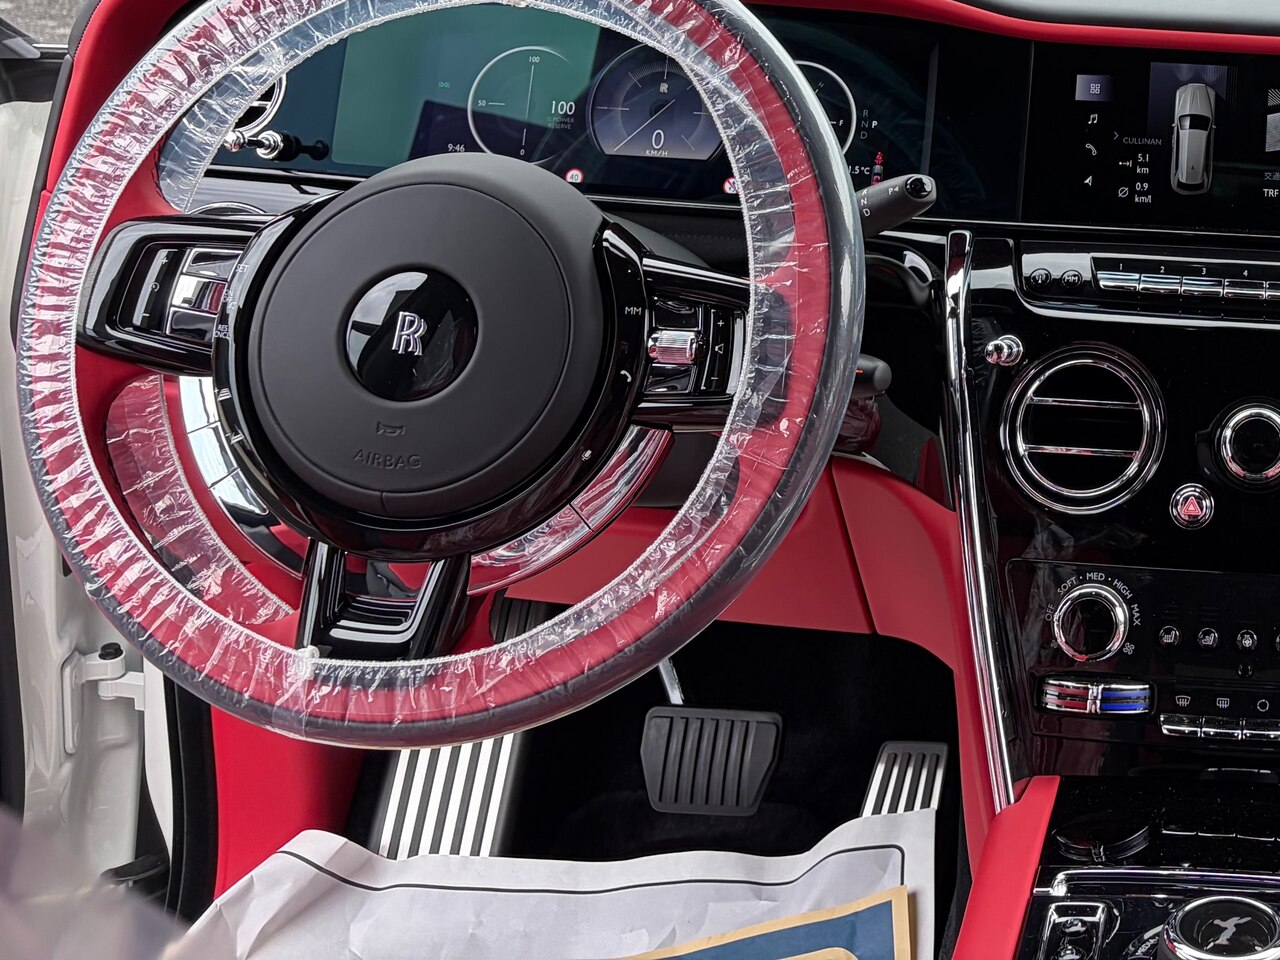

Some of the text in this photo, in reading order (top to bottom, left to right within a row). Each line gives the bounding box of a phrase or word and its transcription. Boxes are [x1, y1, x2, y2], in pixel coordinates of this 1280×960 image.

[551, 101, 576, 115] 100
[863, 109, 869, 117] R
[839, 119, 844, 127] F
[861, 120, 869, 128] N
[871, 120, 878, 129] P
[652, 129, 664, 150] 0
[860, 131, 868, 139] D
[1122, 137, 1162, 145] CULLINAN
[447, 143, 465, 152] 9:46
[645, 149, 668, 157] KM/H
[1137, 153, 1149, 162] 5.1
[1136, 165, 1149, 174] km
[569, 173, 579, 182] 40
[888, 187, 894, 195] P
[1135, 182, 1149, 191] 0.9
[1262, 188, 1279, 197] TRF
[860, 198, 867, 206] N
[863, 208, 871, 217] D
[236, 263, 250, 273] SET
[1202, 267, 1206, 275] 3
[1242, 269, 1248, 277] 4
[624, 306, 643, 315] MM
[217, 324, 229, 332] RES
[353, 448, 422, 469] AIRBAG
[1086, 572, 1105, 581] MED
[1057, 576, 1077, 595] SOFT
[1112, 578, 1133, 599] HIGH
[1045, 603, 1055, 621] OFF
[1130, 603, 1141, 626] MAX
